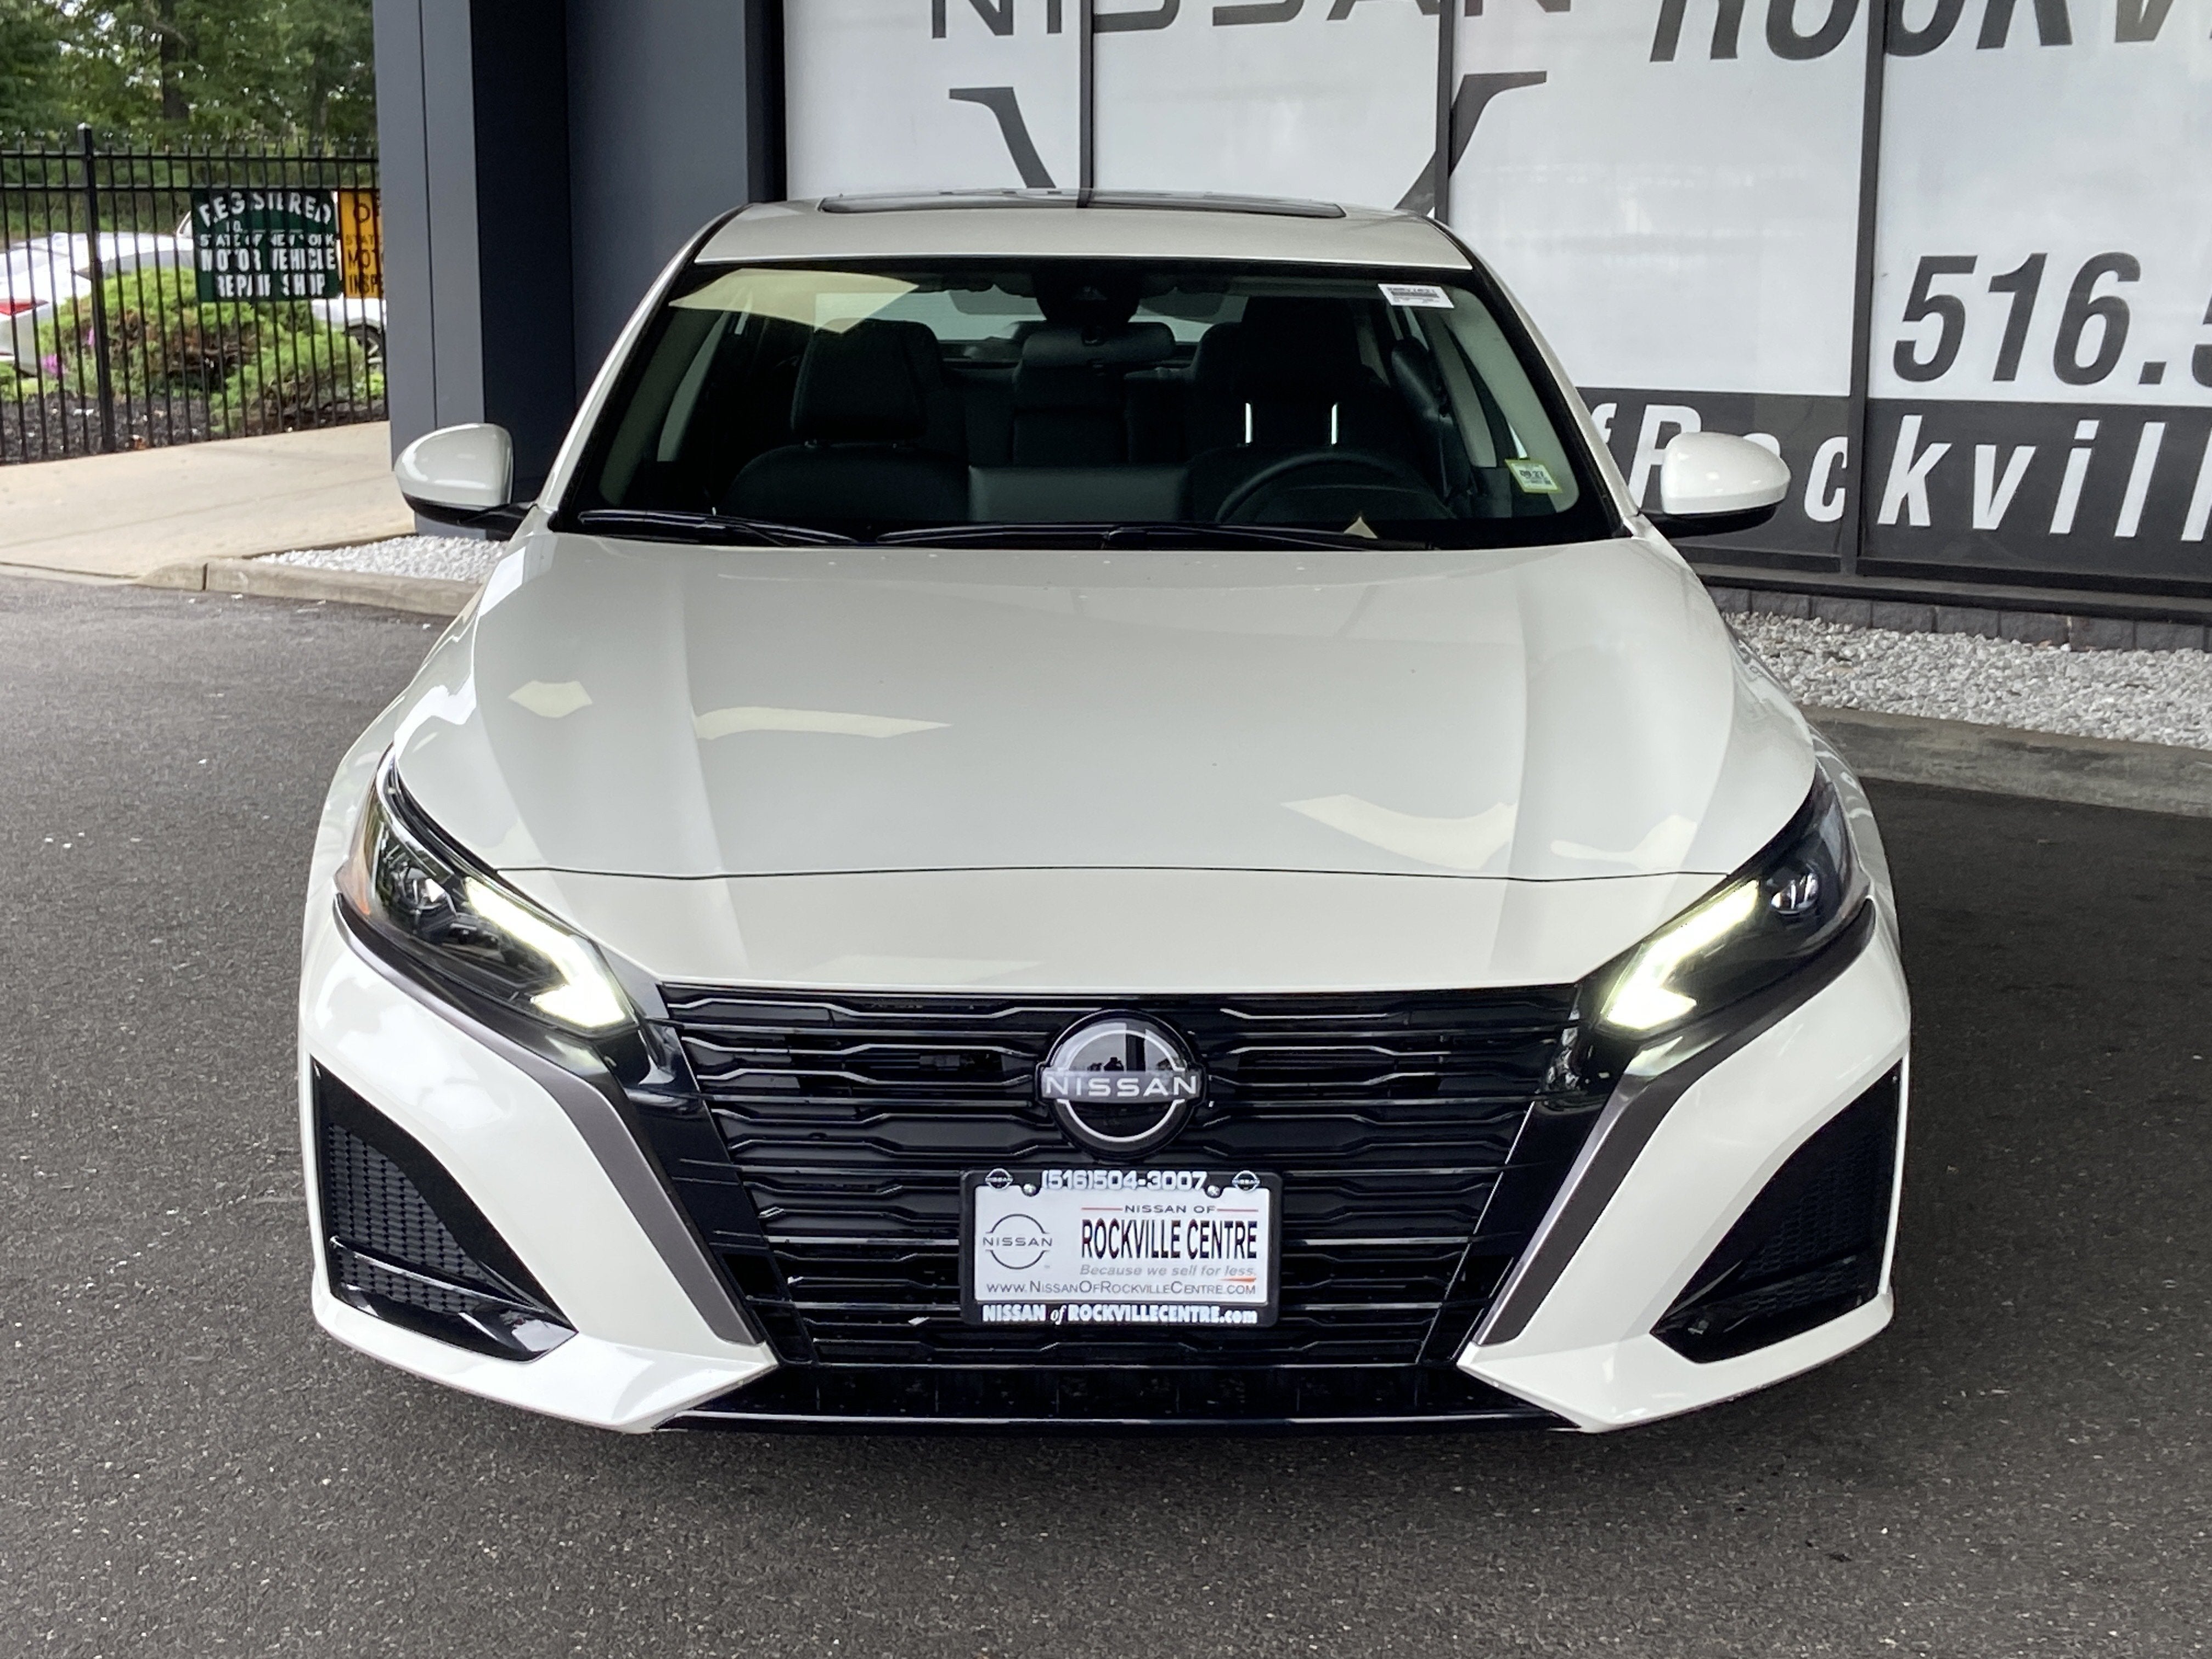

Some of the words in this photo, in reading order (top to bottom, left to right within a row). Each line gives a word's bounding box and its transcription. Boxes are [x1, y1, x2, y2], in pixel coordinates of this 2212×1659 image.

[199, 191, 332, 228] REGSTERED
[1893, 252, 2212, 387] 516.
[1045, 1075, 1197, 1097] NISSAN
[1042, 1169, 1207, 1190] (516)504-3007
[1125, 1205, 1187, 1214] NISSAN
[1193, 1205, 1216, 1214] OF
[983, 1237, 1053, 1247] NISSAN
[1081, 1218, 1181, 1260] ROCKVILLE
[1187, 1218, 1258, 1260] CENTRE
[1080, 1264, 1143, 1276] Because
[1147, 1267, 1167, 1276] we
[1172, 1265, 1198, 1276] sell
[1200, 1265, 1221, 1277] for
[982, 1304, 1046, 1322] NISSAN
[1049, 1304, 1067, 1325] of
[1068, 1304, 1258, 1324] ROCKVILLECENTRE.com
